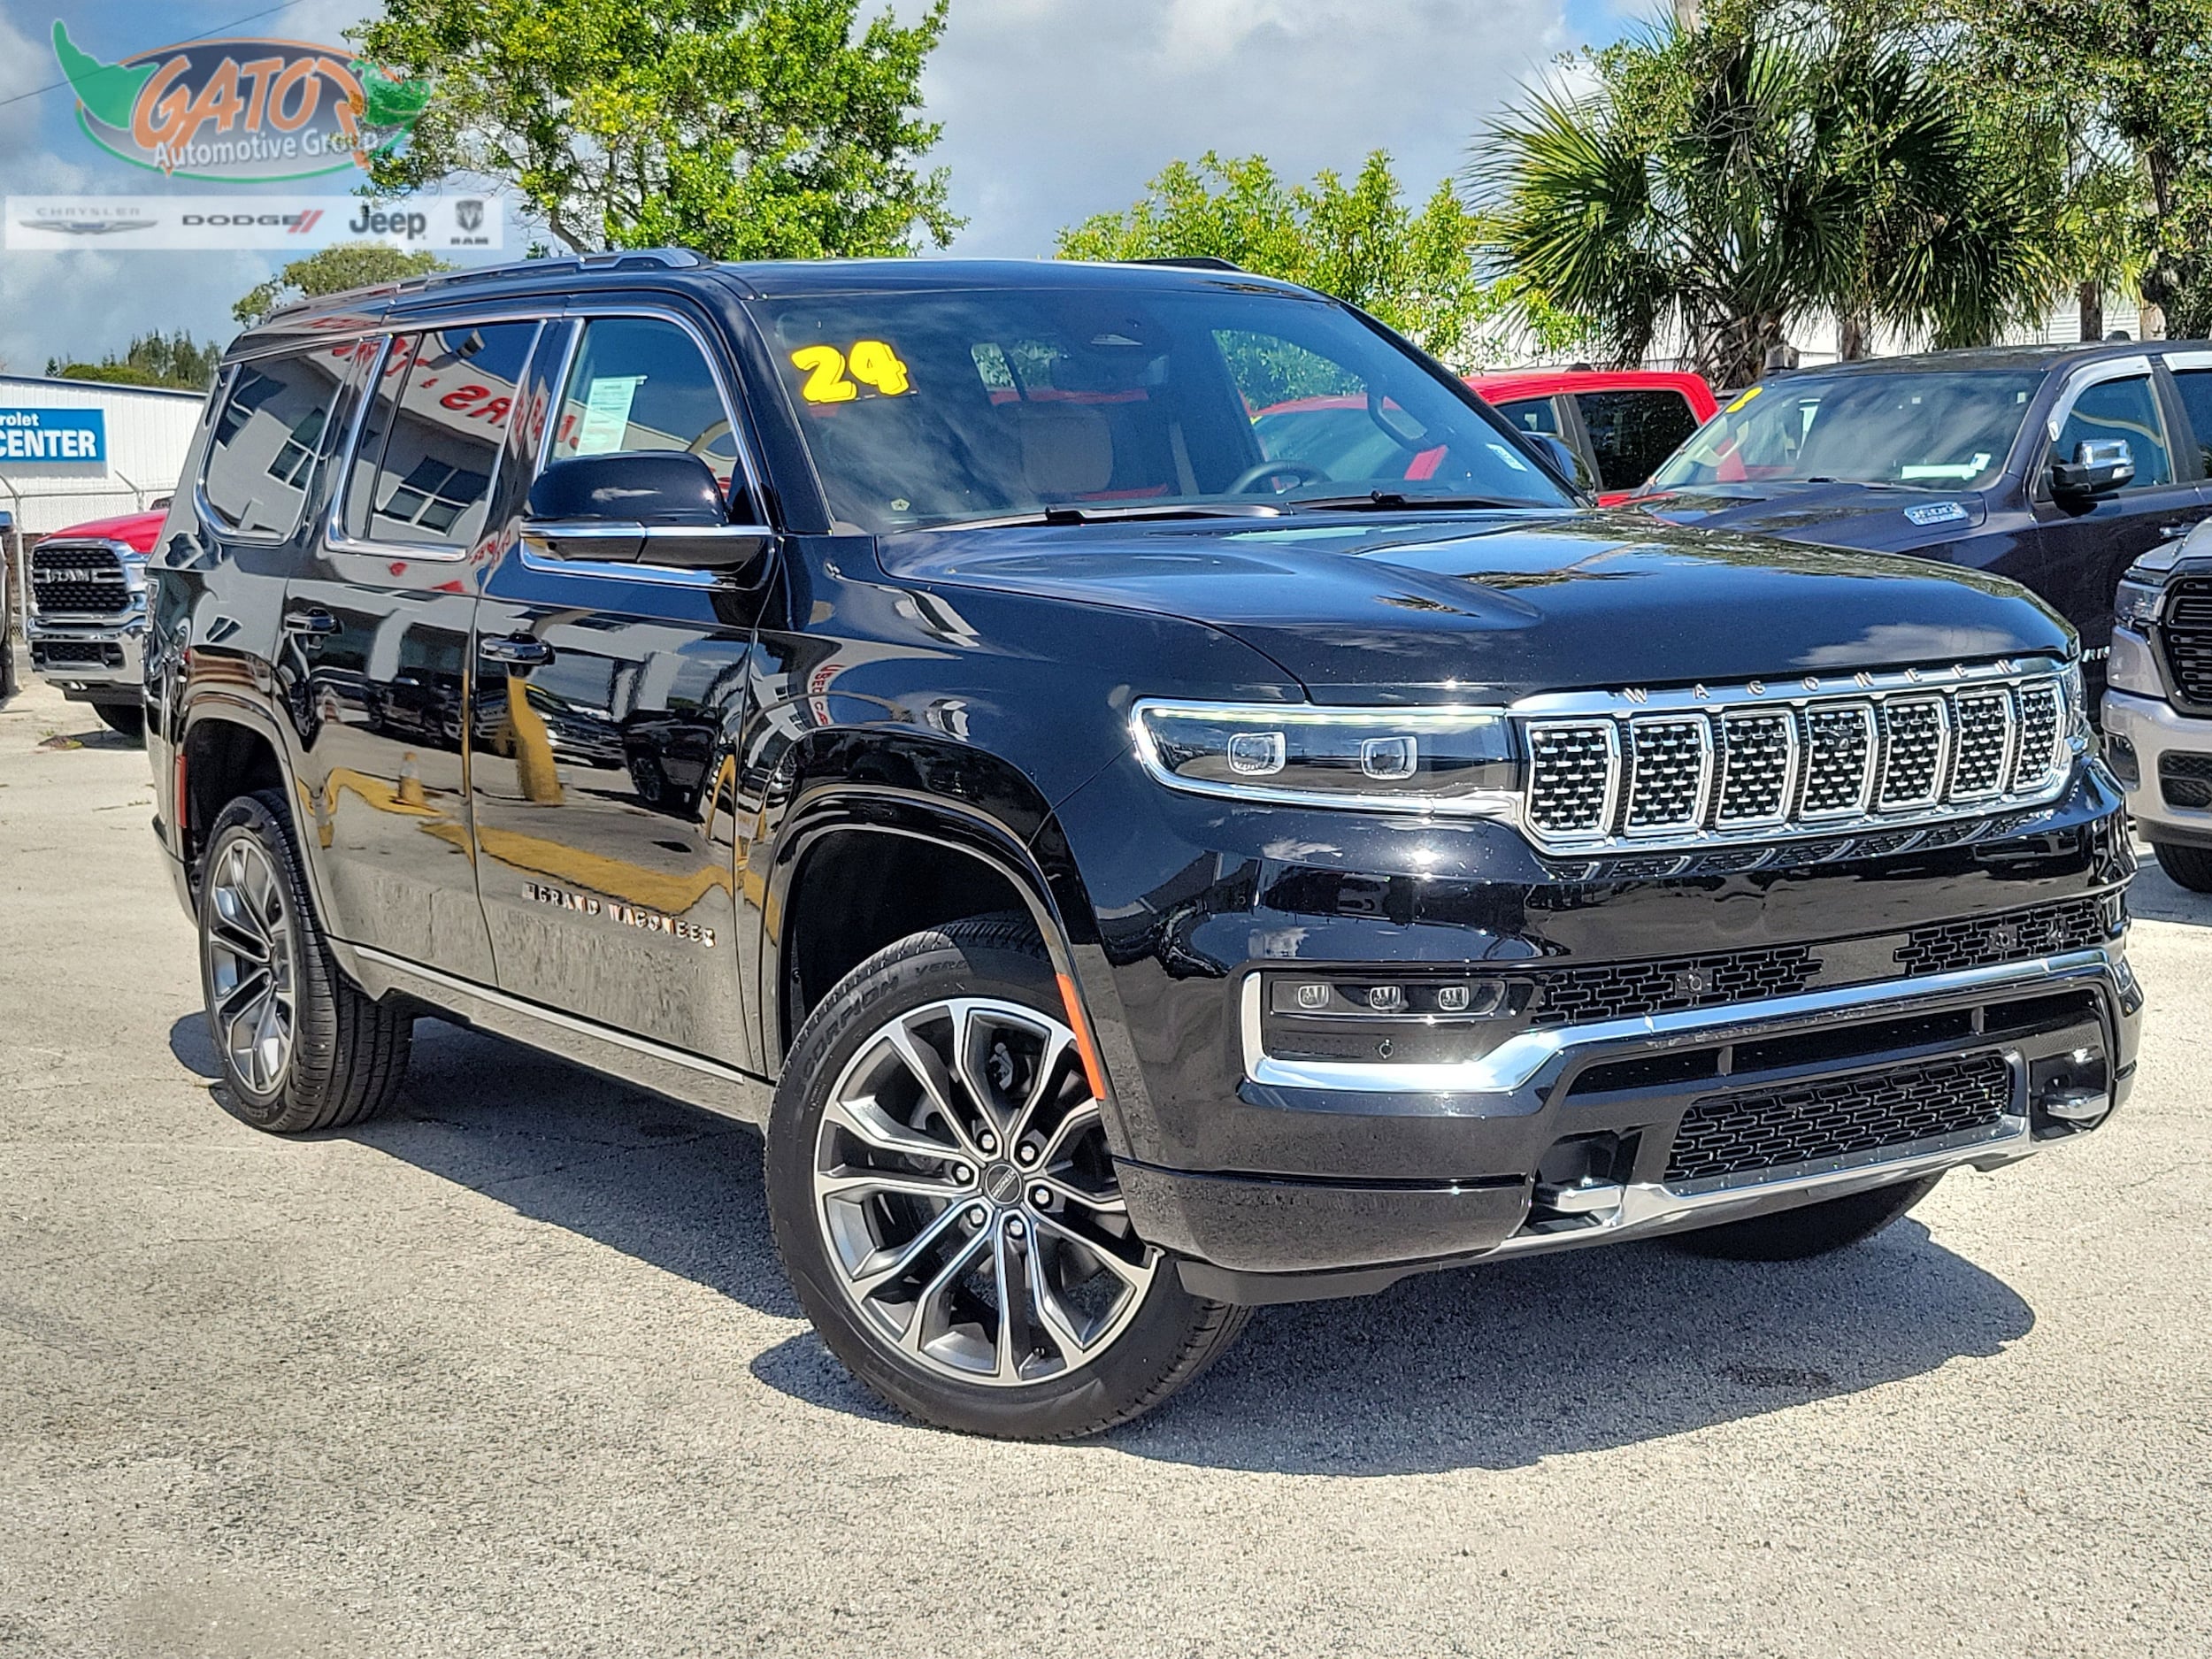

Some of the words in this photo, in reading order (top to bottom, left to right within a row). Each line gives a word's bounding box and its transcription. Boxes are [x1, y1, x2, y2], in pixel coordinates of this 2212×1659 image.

[791, 339, 910, 403] 24
[50, 567, 90, 583] RAM
[1623, 657, 2022, 705] WAGONEER
[539, 887, 601, 916] GRAND
[609, 902, 716, 948] WAGONEER
